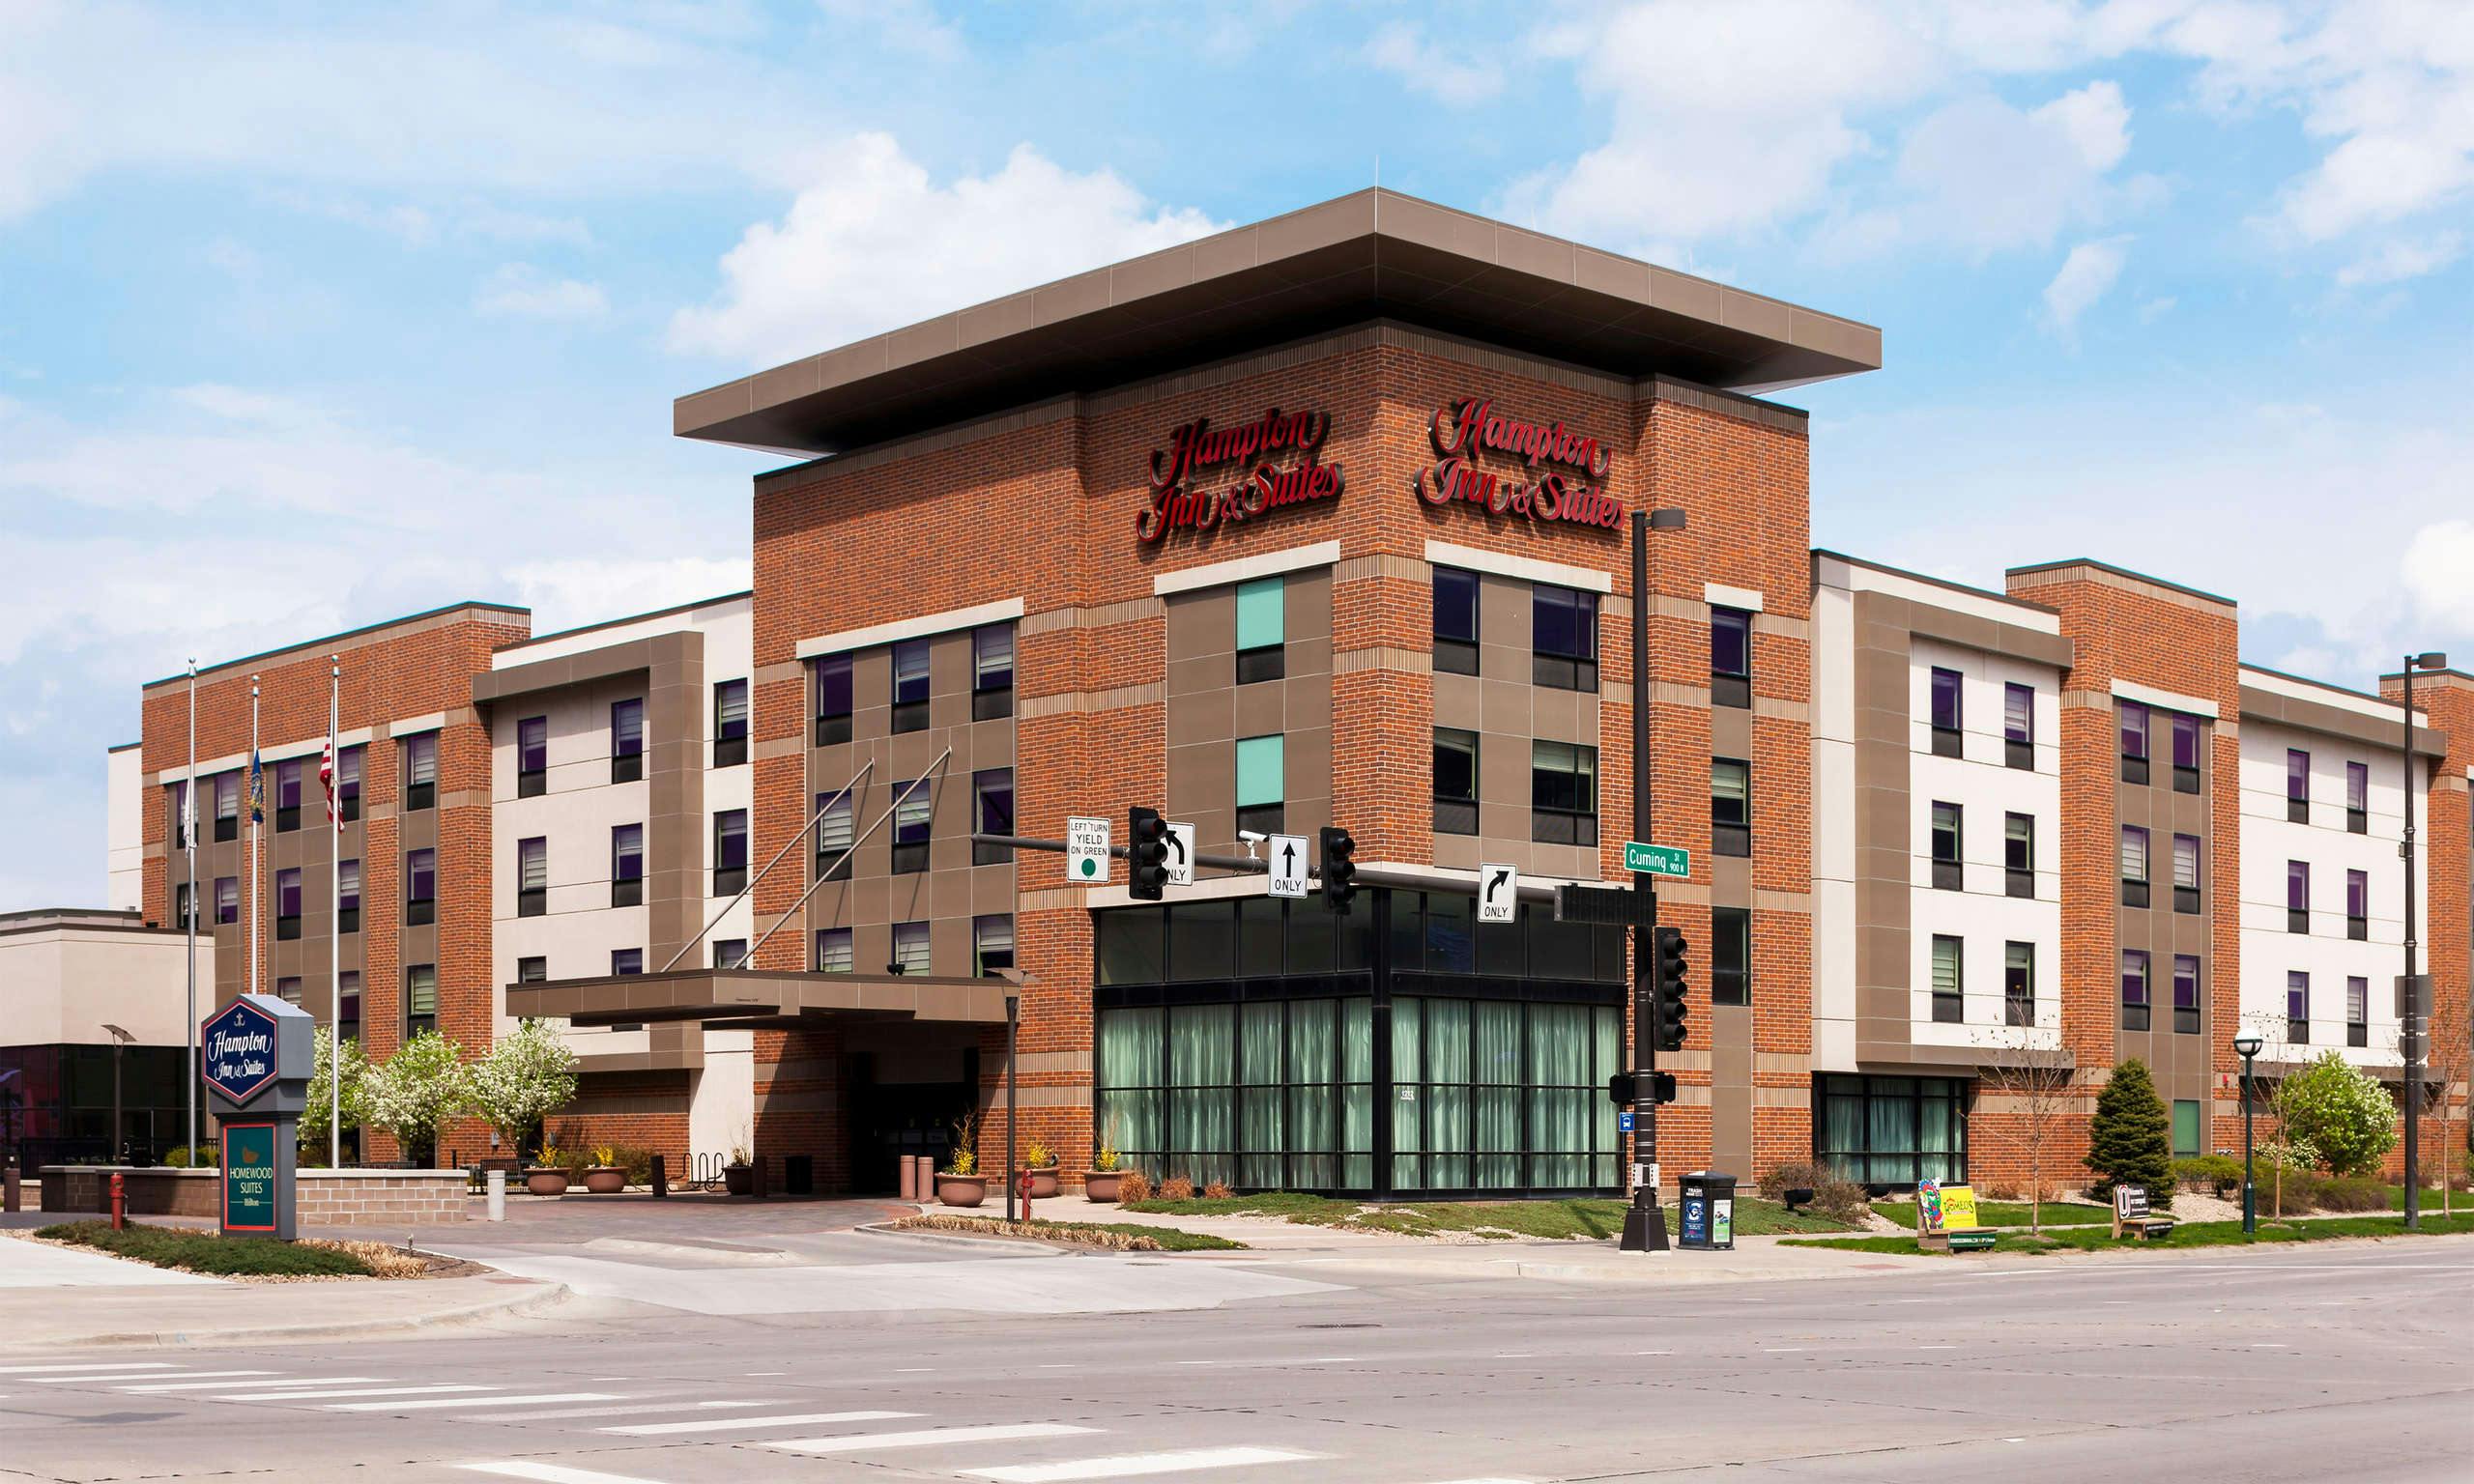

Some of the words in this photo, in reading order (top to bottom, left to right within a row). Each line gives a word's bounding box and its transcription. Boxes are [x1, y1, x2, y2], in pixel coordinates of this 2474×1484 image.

[1428, 397, 1612, 477] Hampton
[1149, 408, 1332, 488] Hampton
[1136, 486, 1222, 542] Inn
[1242, 456, 1345, 516] Suites
[1414, 457, 1512, 515] Inn
[1533, 472, 1625, 530] Suites
[1070, 821, 1087, 832] LEFT
[1089, 823, 1108, 833] TURN
[1076, 834, 1104, 845] YIELD
[1071, 845, 1081, 855] ON
[1083, 846, 1108, 857] GREEN
[1629, 849, 1666, 872] Cuming
[1166, 869, 1187, 881] NLY
[1275, 878, 1302, 892] ONLY
[1484, 905, 1509, 918] ONLY
[208, 1029, 273, 1062] Hampton
[214, 1061, 236, 1080] Inn
[240, 1058, 266, 1077] Suites
[229, 1167, 273, 1179] HOMEWOOD
[240, 1182, 263, 1194] SUITES
